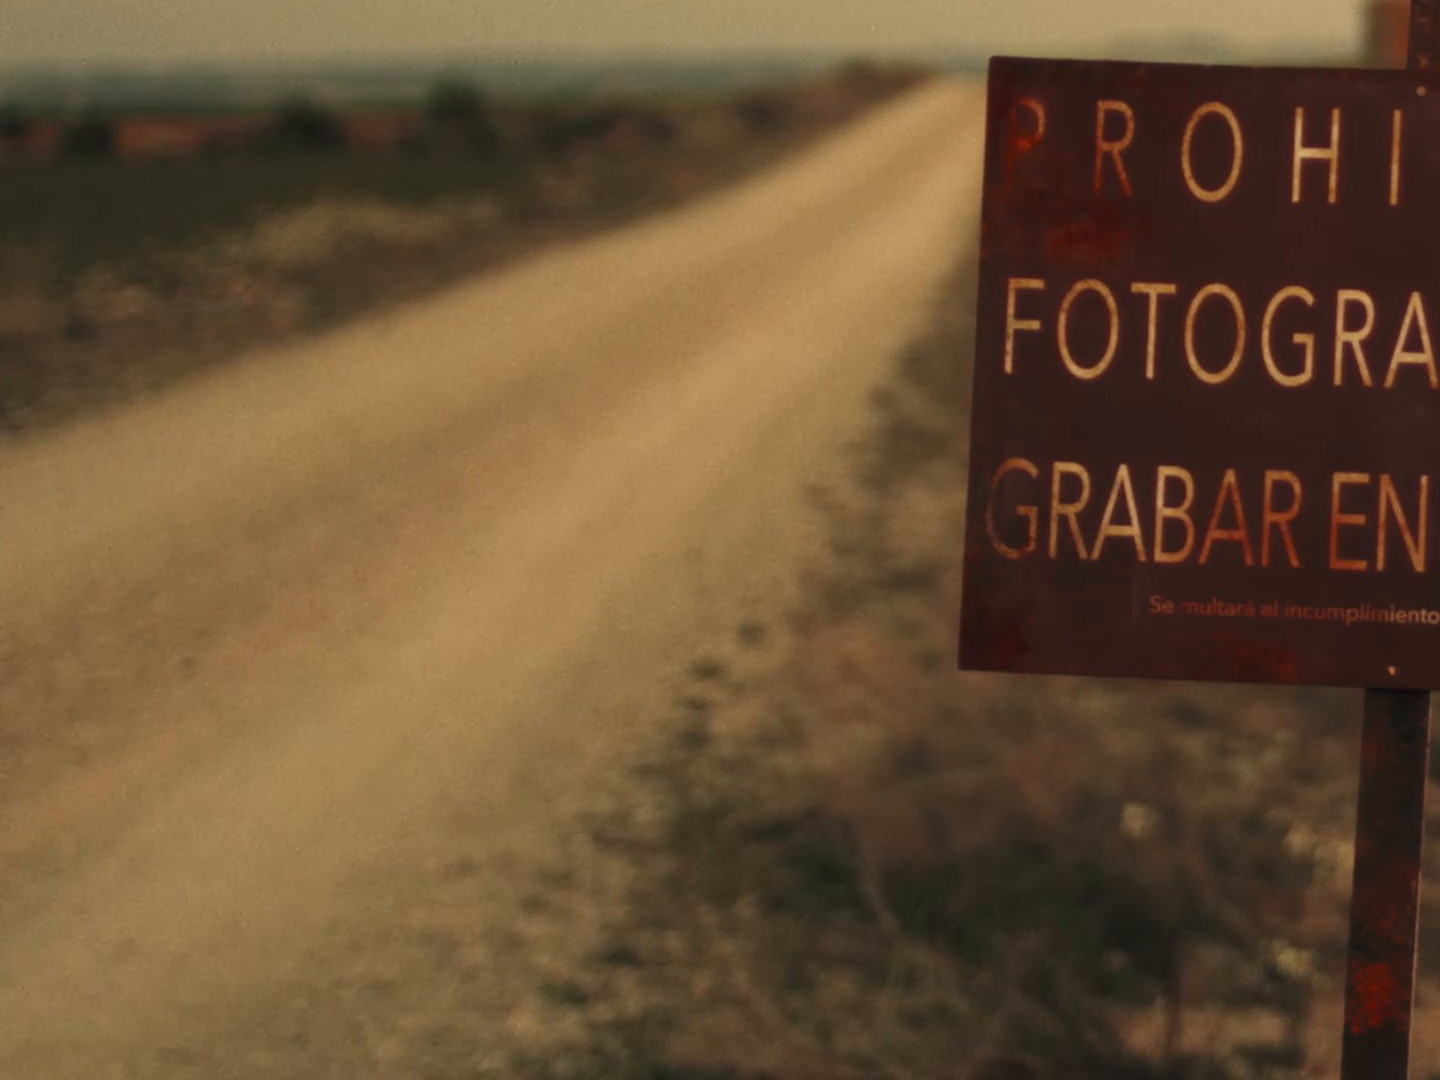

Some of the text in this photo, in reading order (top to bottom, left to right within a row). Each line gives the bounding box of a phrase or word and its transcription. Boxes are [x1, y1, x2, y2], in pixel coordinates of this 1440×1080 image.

[985, 457, 1301, 569] GRABAR
[1329, 471, 1430, 573] EN
[1149, 594, 1175, 614] Se
[1179, 595, 1256, 617] multará
[1260, 598, 1279, 617] el
[1285, 601, 1440, 626] incumplimiento
